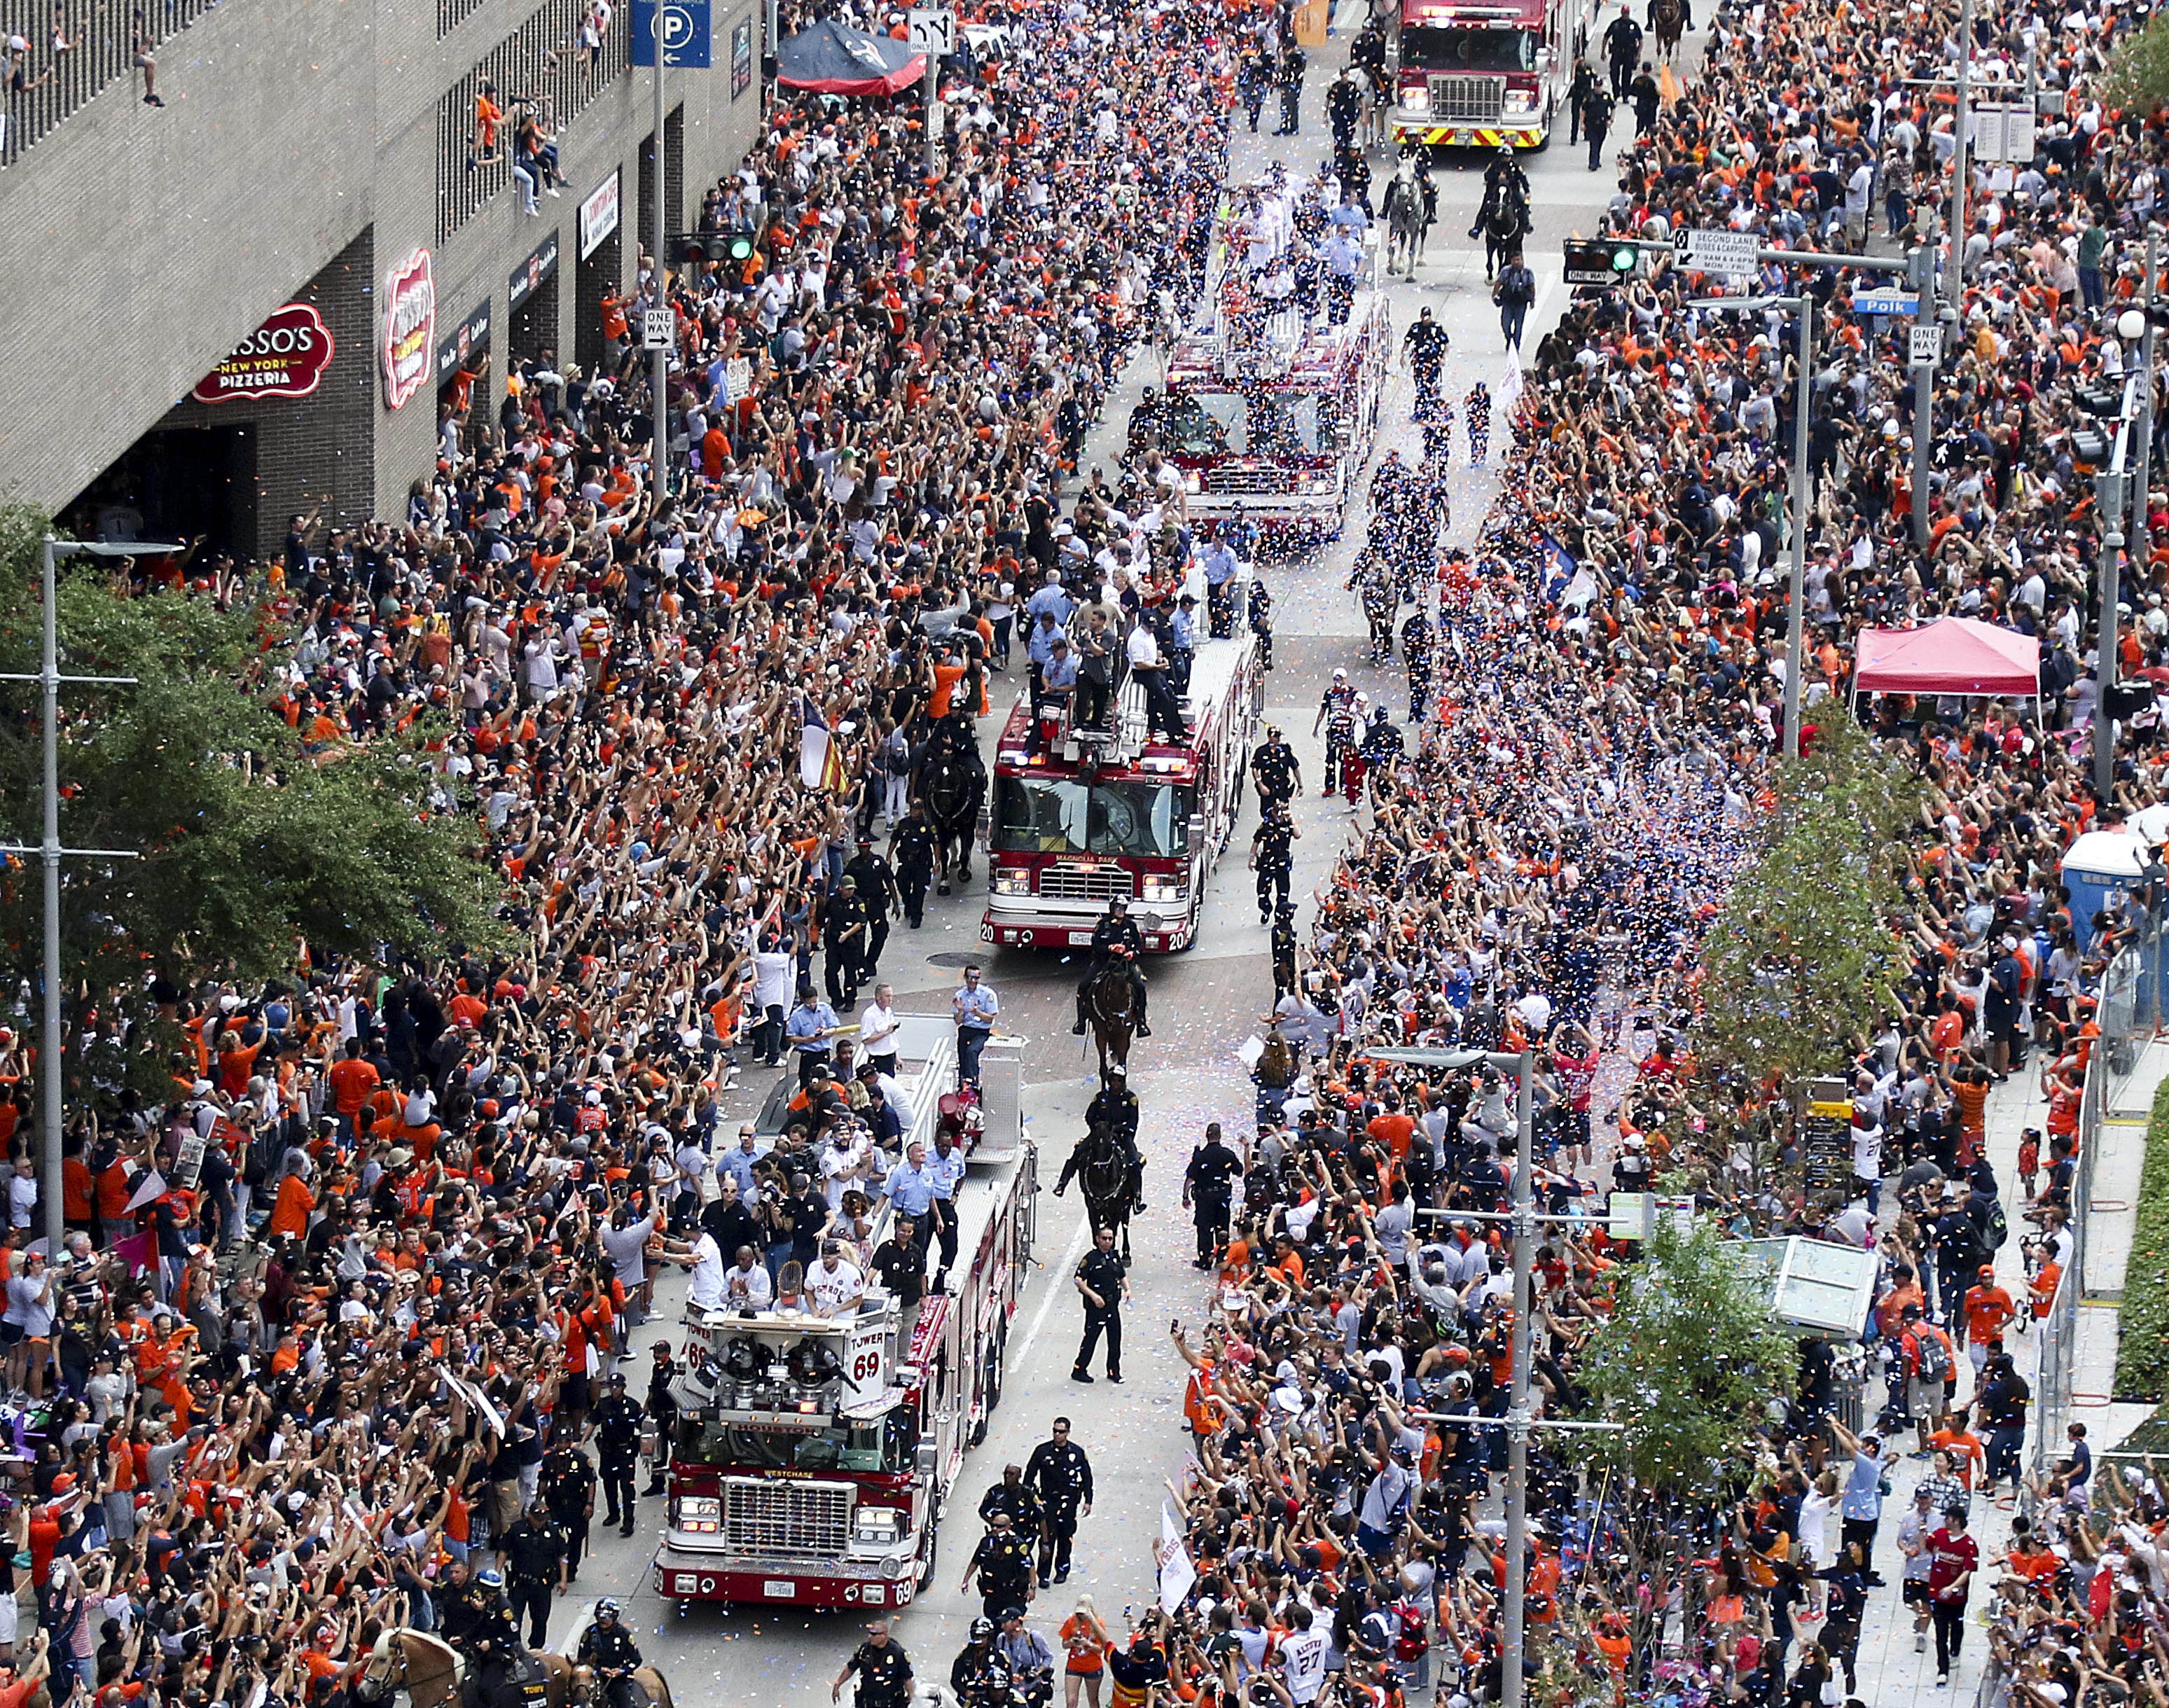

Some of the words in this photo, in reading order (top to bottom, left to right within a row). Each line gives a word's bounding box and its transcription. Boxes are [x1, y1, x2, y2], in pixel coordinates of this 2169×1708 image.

[665, 16, 683, 40] P
[1697, 233, 1731, 244] SECOND
[1733, 236, 1753, 245] LANE
[1721, 244, 1755, 254] CARPOOLS
[1866, 300, 1905, 312] Polk
[648, 312, 671, 322] ONE
[648, 324, 671, 333] WAY
[1913, 329, 1937, 338] ONE
[1913, 341, 1937, 349] WAY
[220, 362, 251, 374] NEW
[254, 359, 289, 371] YORK
[219, 371, 291, 389] PIZZERIA
[1055, 854, 1095, 863] MAGNOLIA
[980, 923, 994, 942] 20
[1168, 932, 1184, 951] 20
[687, 1322, 711, 1340] TOWER
[852, 1333, 884, 1350] TOWER
[854, 1352, 880, 1382] 69
[737, 1424, 815, 1435] HOUSTON
[764, 1469, 814, 1478] WESTCHASE
[896, 1580, 911, 1605] 69
[1300, 1650, 1320, 1676] 27
